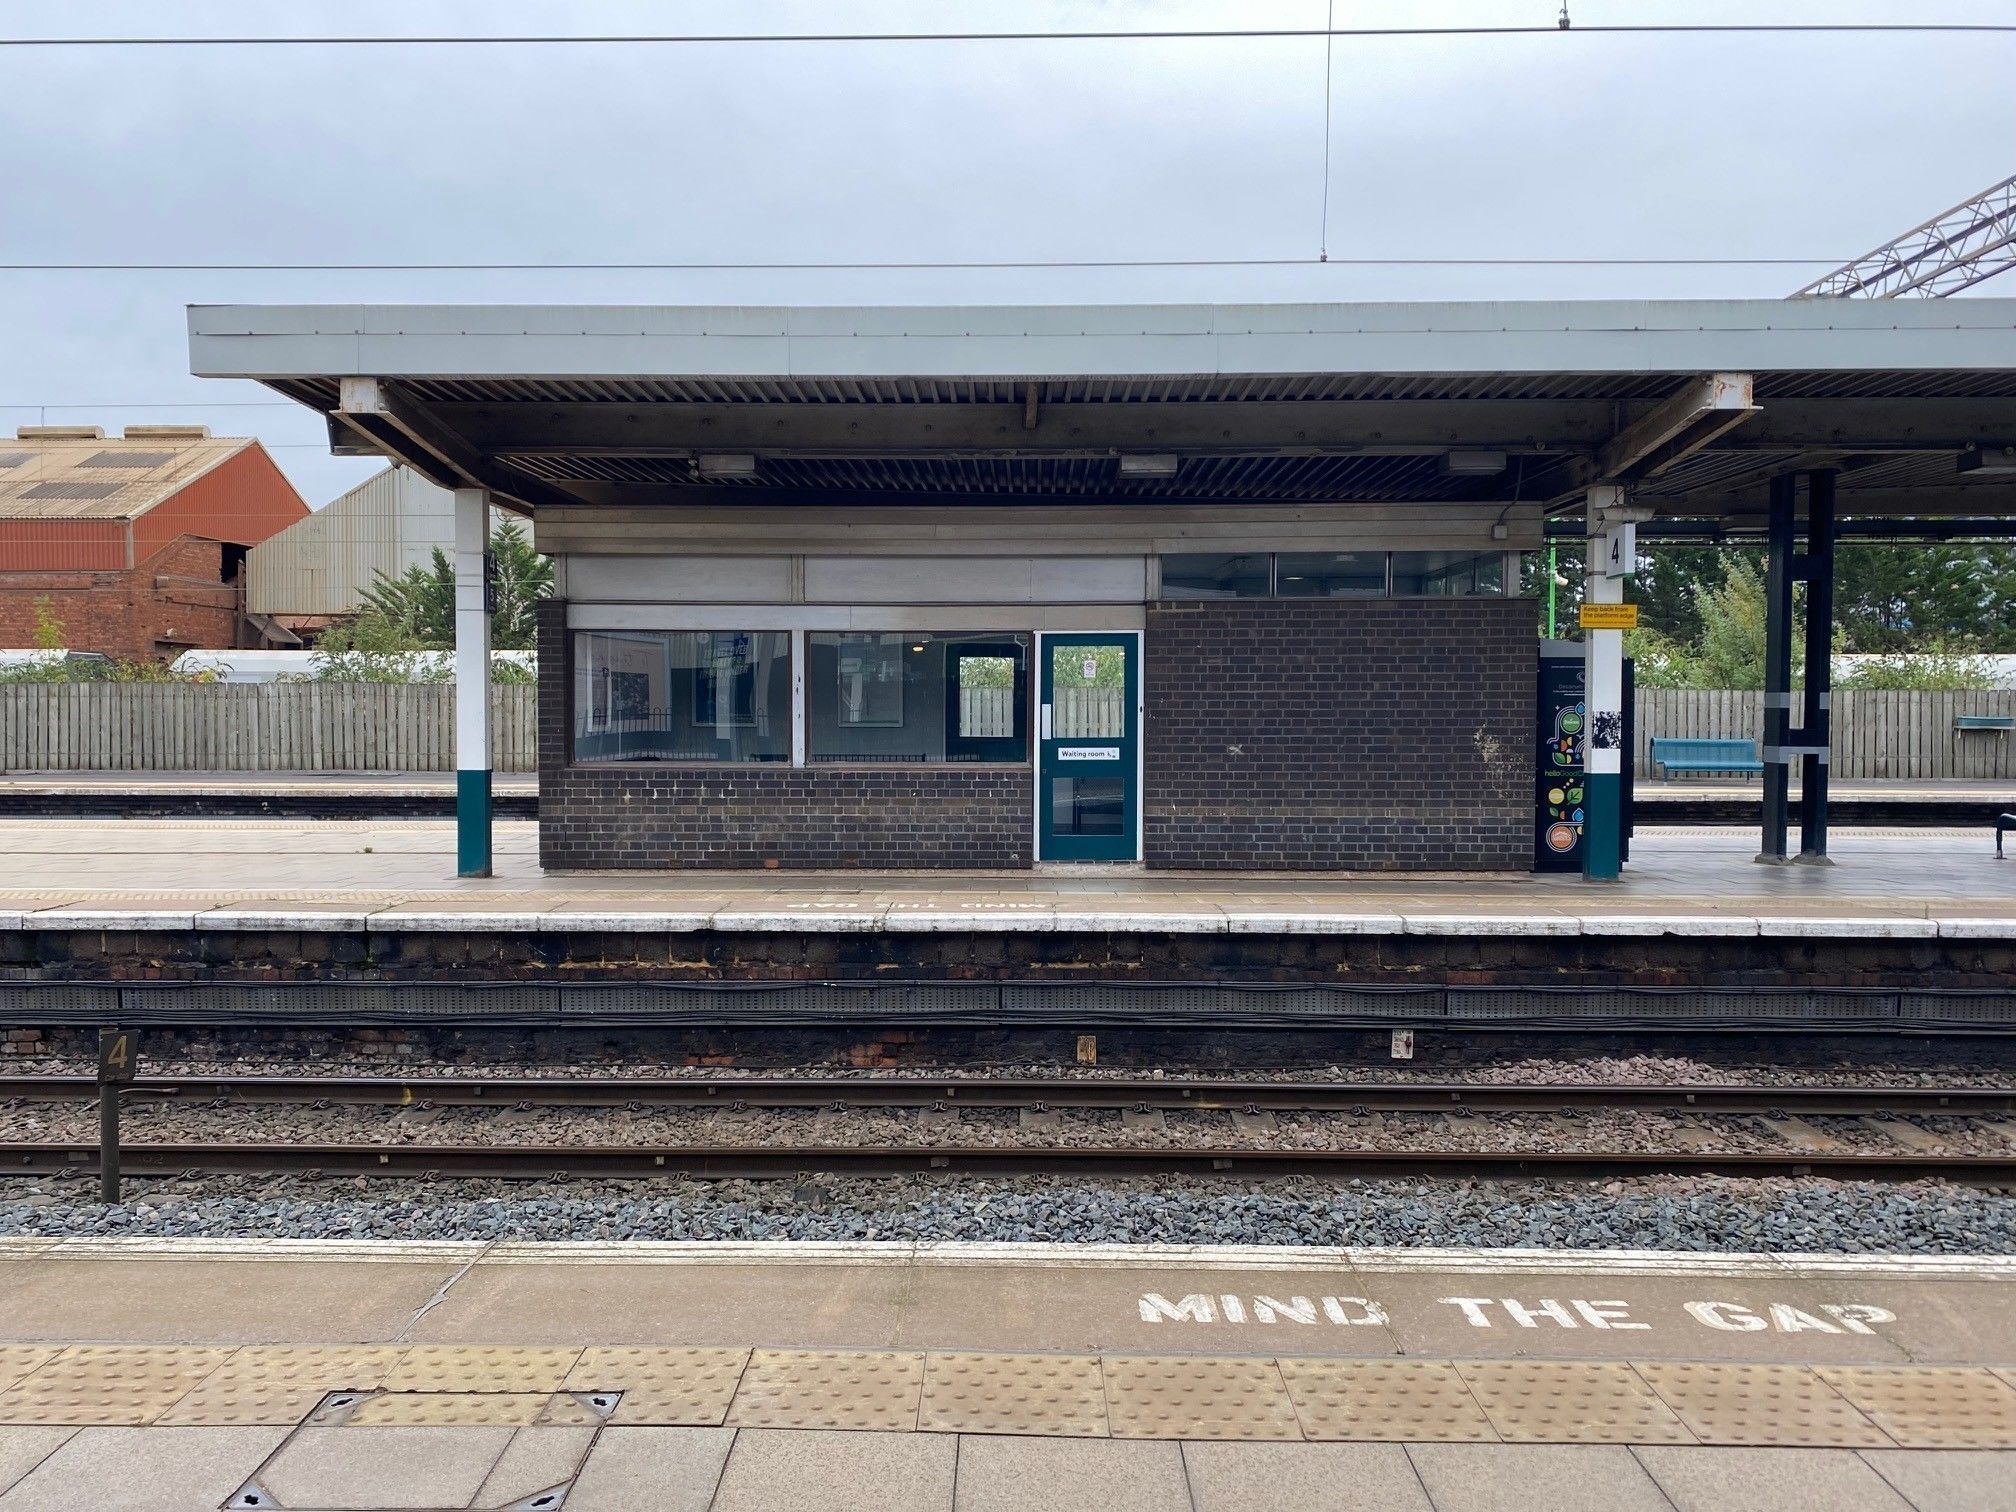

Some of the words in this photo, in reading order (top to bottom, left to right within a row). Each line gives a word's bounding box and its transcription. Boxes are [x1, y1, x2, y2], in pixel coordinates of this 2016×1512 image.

[1611, 537, 1619, 564] 4
[1062, 750, 1087, 758] Waiting
[108, 1035, 128, 1068] 4
[1138, 1293, 1390, 1326] MIND
[1437, 1296, 1653, 1330] THE
[1684, 1300, 1897, 1335] GAP
